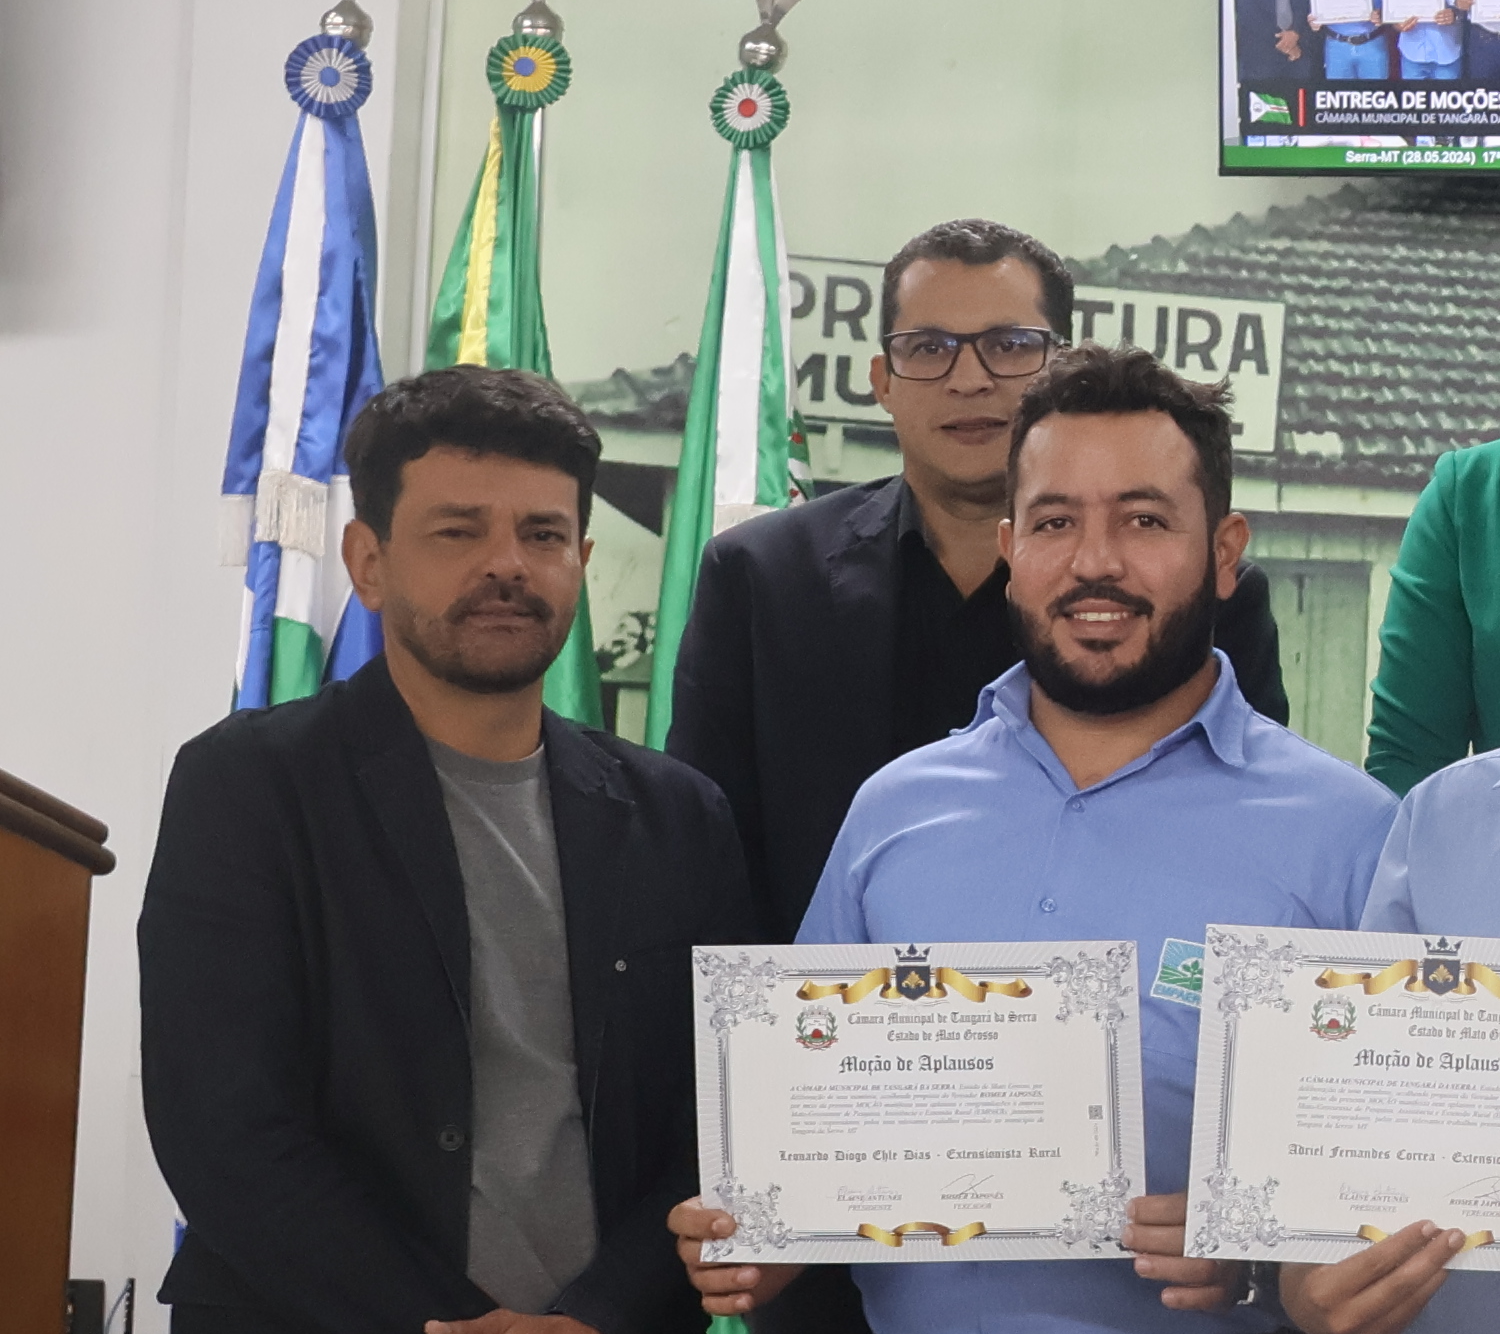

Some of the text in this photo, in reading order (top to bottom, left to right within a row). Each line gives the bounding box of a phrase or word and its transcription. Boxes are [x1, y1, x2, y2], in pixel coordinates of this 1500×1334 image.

[1315, 91, 1398, 110] ENTREGA
[1402, 91, 1426, 109] DE
[1315, 111, 1360, 124] CÂMARA
[1362, 113, 1419, 124] MUNICIPAL
[1422, 113, 1435, 124] DE
[1438, 111, 1488, 124] TANGARÁ
[1346, 150, 1400, 164] Serra-MT
[1402, 150, 1475, 166] (28.05.2024)
[839, 1054, 993, 1076] Moção de Aplausos
[1354, 1048, 1410, 1071] Moção
[1417, 1052, 1434, 1069] de
[904, 1149, 931, 1160] Dias
[947, 1148, 1021, 1160] Extensionista
[1329, 1145, 1390, 1159] Fernandes
